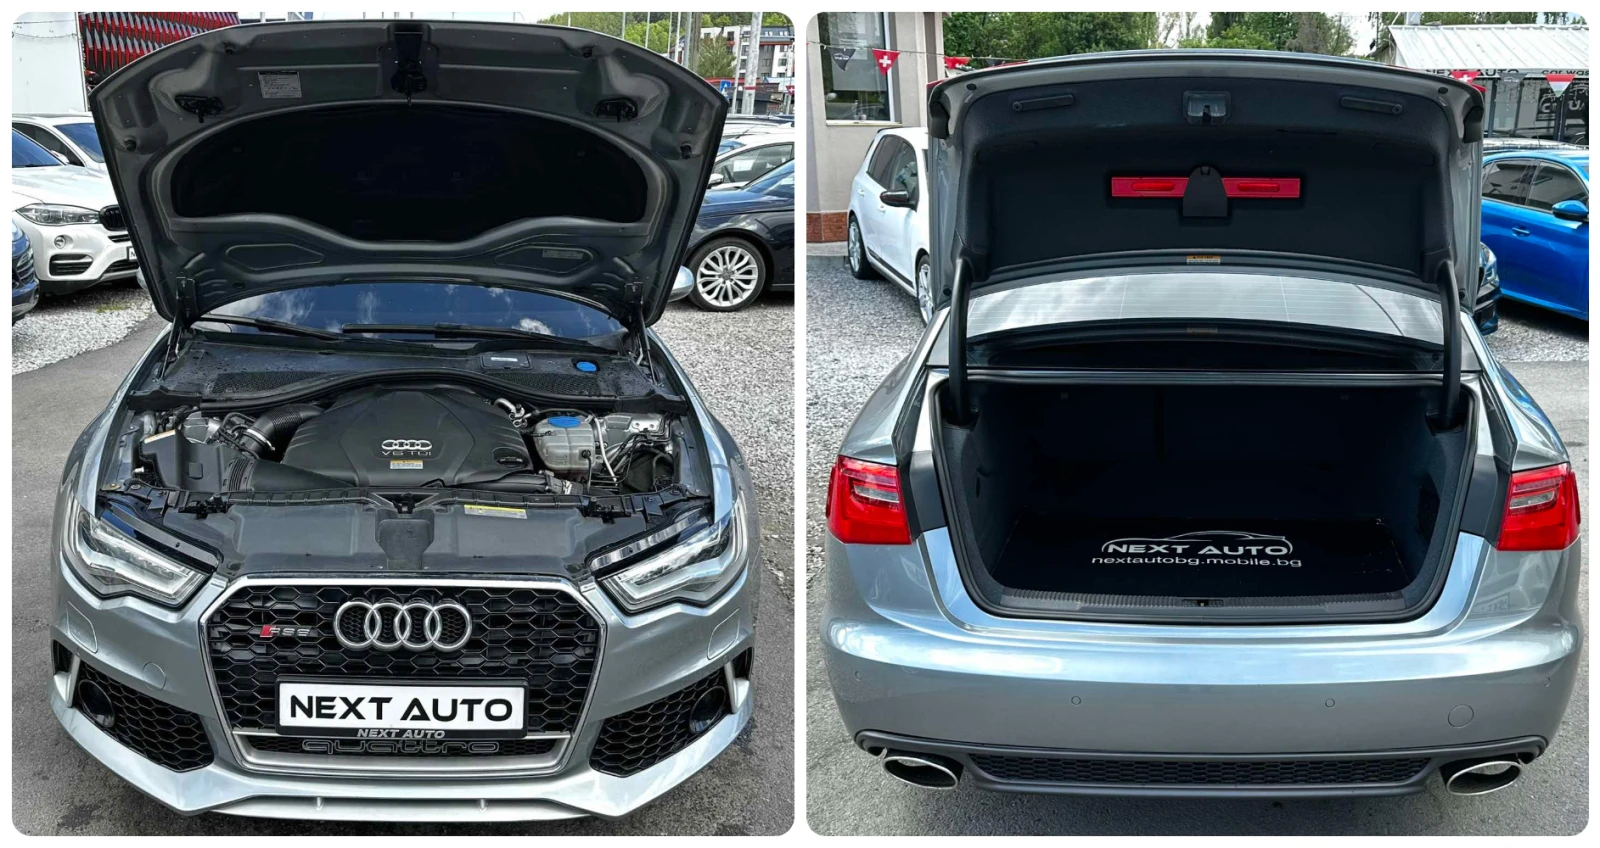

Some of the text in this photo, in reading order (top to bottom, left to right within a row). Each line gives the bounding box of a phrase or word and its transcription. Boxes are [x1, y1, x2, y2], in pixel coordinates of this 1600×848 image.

[1107, 544, 1288, 555] NEXT AUTO
[1091, 556, 1302, 567] nextautobg.mobile.bg
[290, 695, 513, 722] NEXT AUTO
[357, 728, 446, 739] NEXT AUTO
[302, 739, 500, 754] quattro
